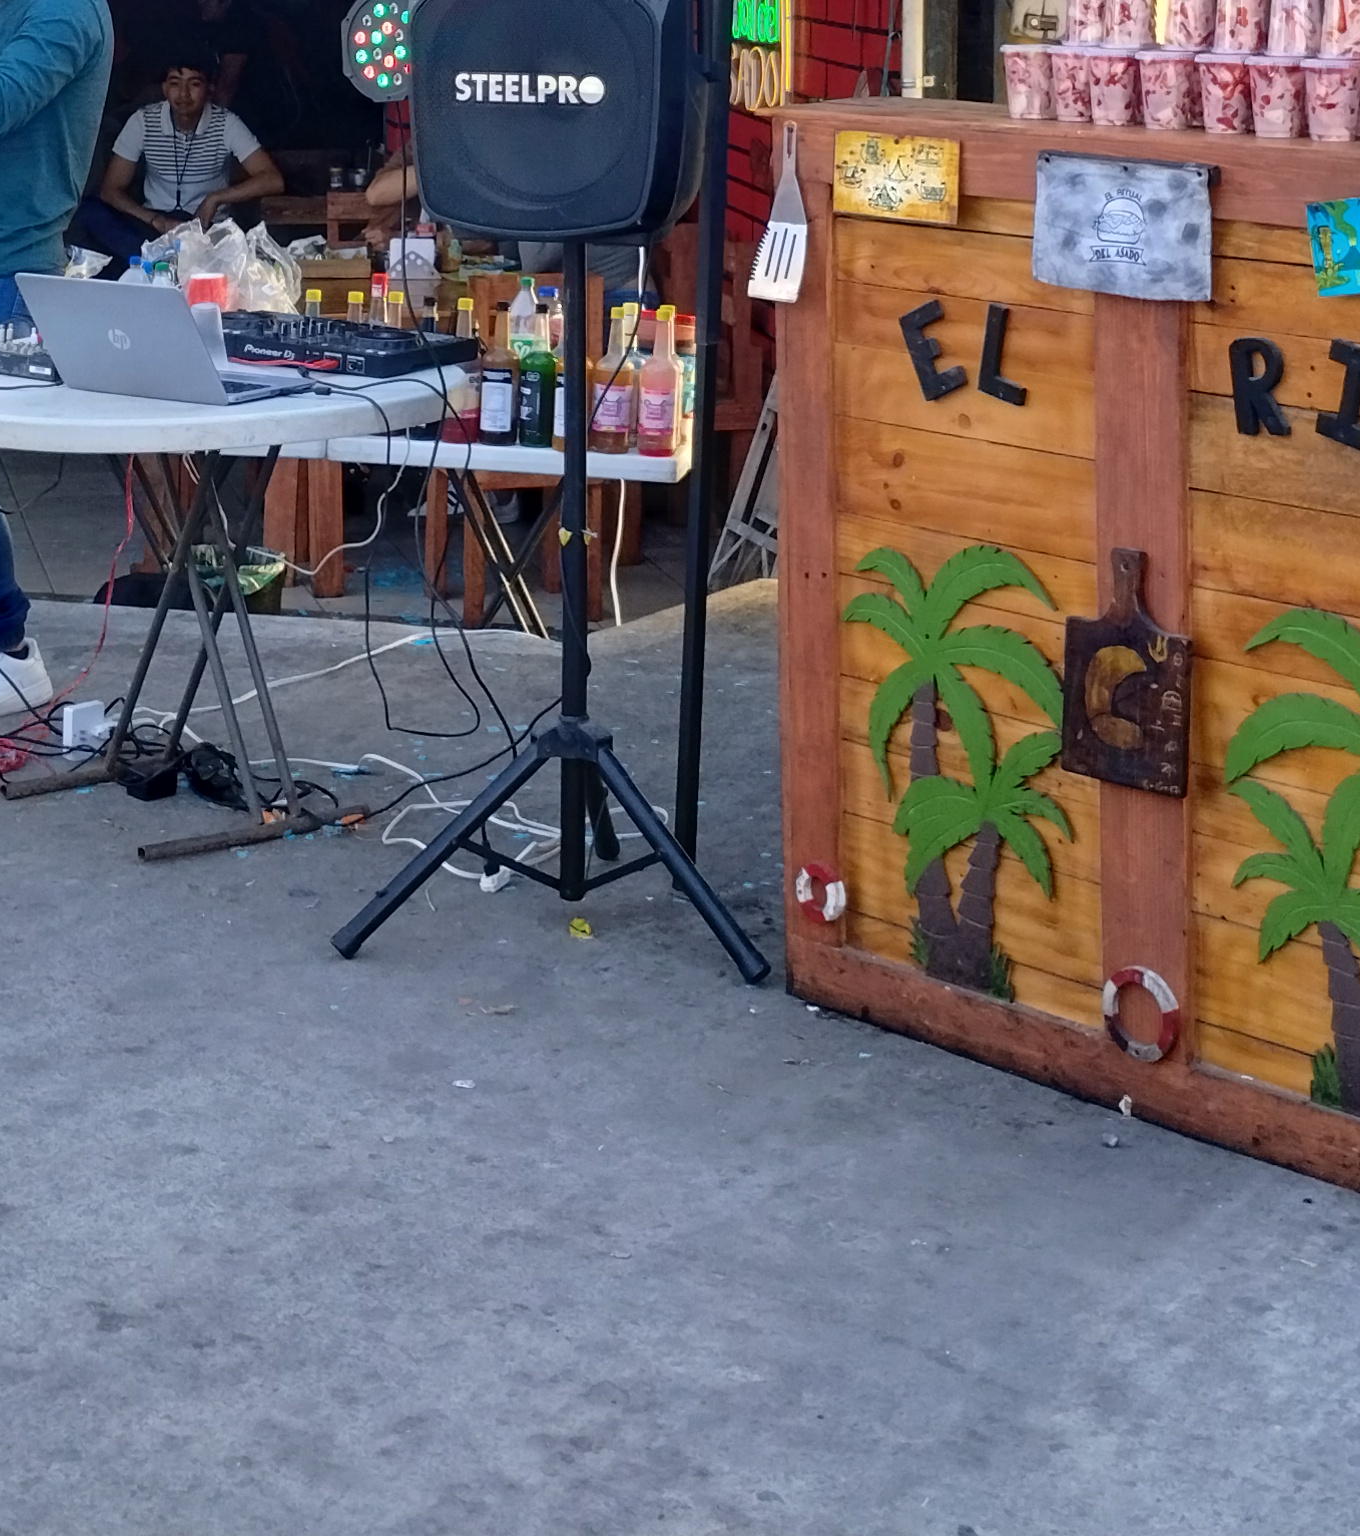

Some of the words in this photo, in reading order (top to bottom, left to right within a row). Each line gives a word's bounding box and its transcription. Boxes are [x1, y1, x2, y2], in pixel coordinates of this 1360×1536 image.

[454, 72, 606, 105] STEELPRO
[107, 328, 131, 350] hp
[243, 344, 283, 358] Pioneer
[898, 299, 1028, 407] EL
